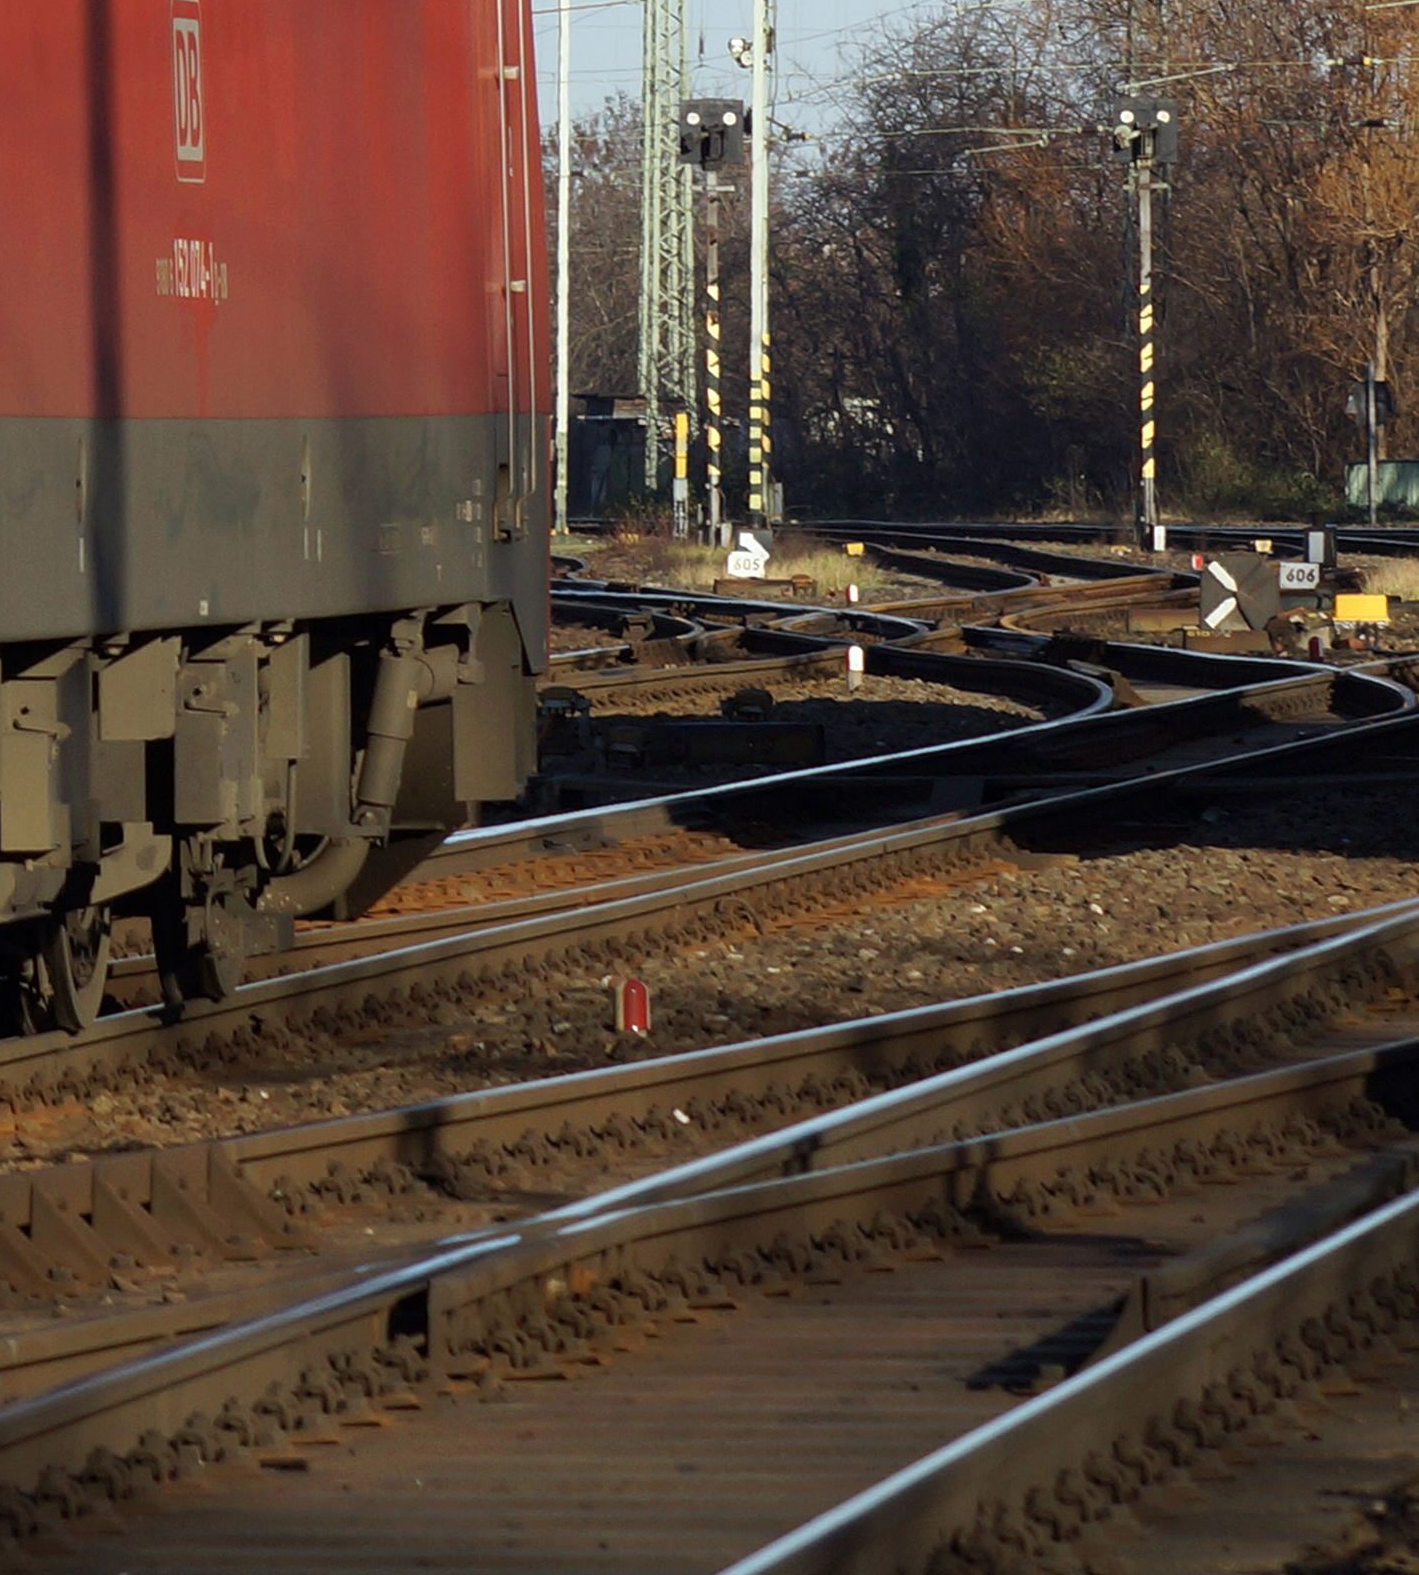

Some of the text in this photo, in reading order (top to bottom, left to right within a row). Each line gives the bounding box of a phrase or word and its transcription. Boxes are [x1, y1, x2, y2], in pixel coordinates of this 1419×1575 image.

[175, 29, 201, 147] DB
[734, 557, 761, 571] 605
[1286, 568, 1315, 583] 606
